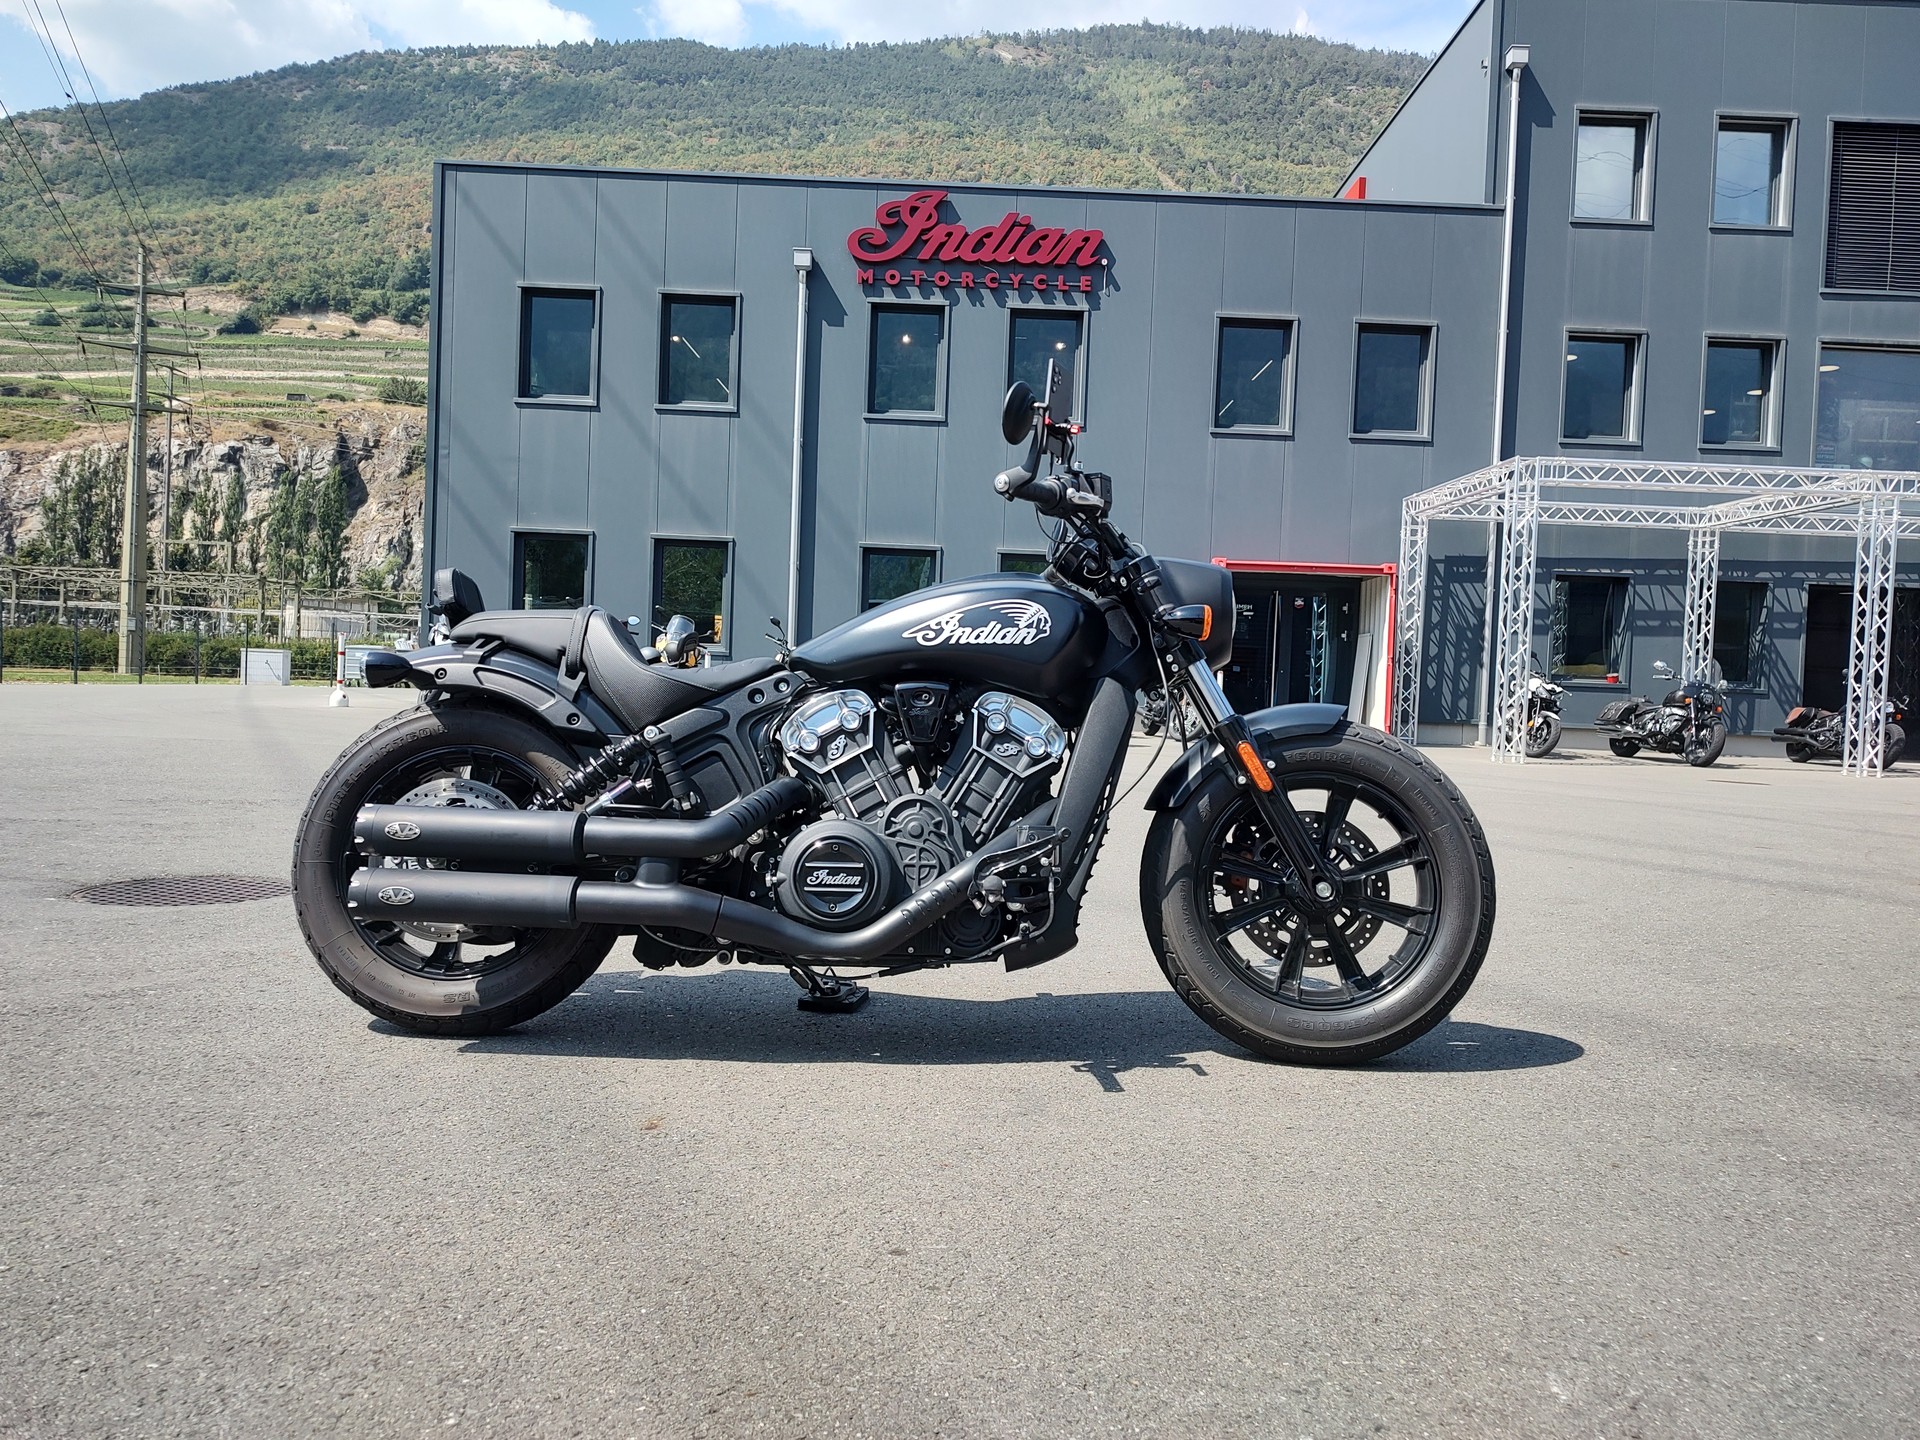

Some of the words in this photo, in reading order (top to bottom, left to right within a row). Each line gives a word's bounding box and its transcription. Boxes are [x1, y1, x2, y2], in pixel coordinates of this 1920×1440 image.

[846, 189, 1104, 267] Indian
[857, 268, 1093, 291] MOTORCYCLE
[916, 613, 1037, 646] Indian
[323, 752, 378, 823] PIRELLI
[807, 869, 862, 886] Indian
